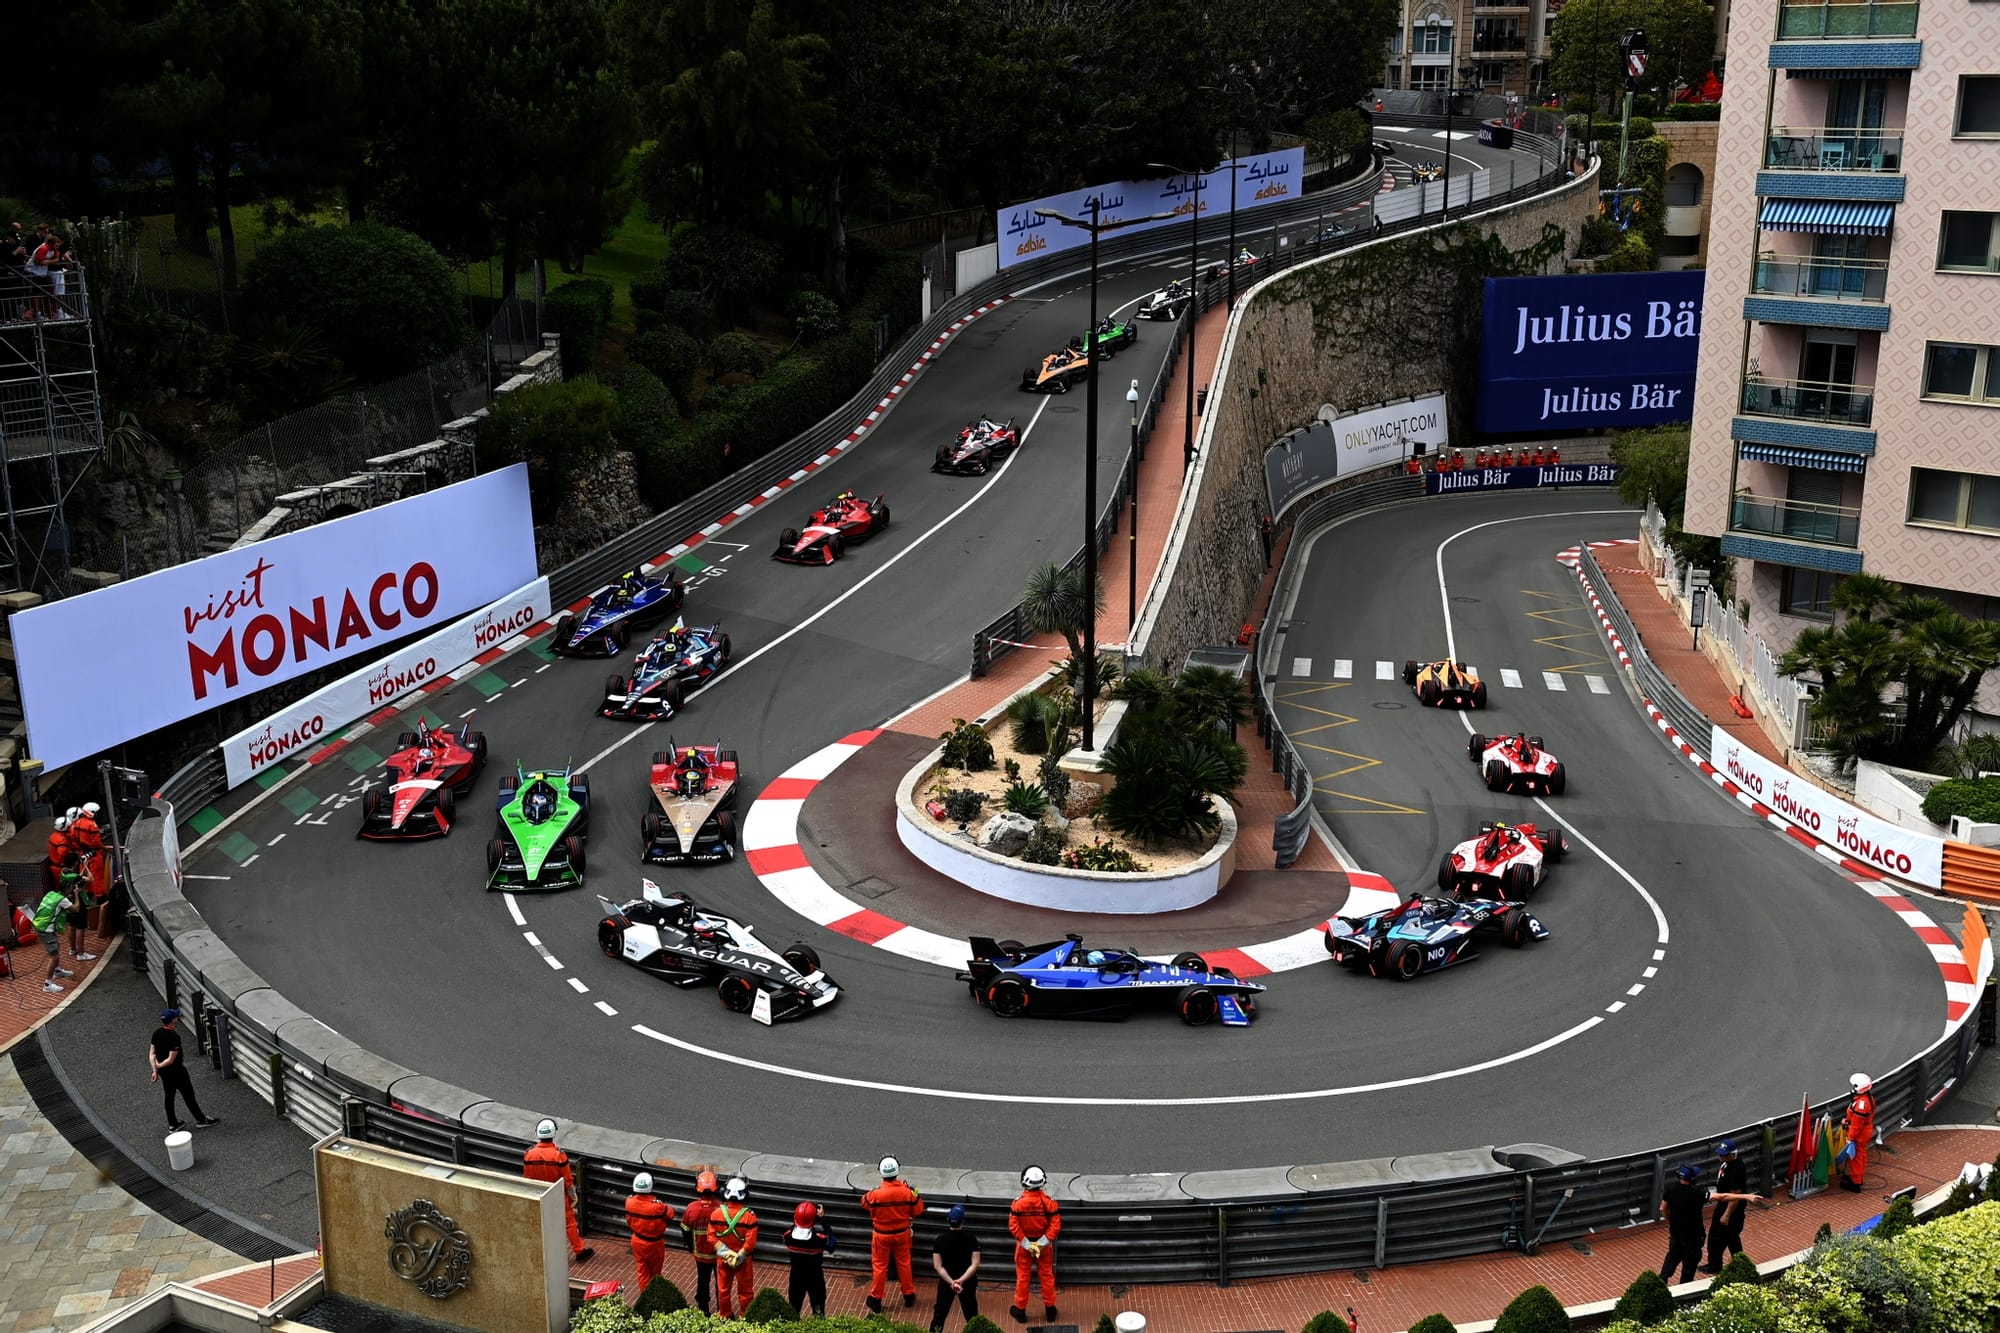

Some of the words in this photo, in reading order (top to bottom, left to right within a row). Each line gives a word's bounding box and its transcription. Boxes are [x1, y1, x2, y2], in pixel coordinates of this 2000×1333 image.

[1244, 160, 1288, 183] سابك
[1254, 181, 1288, 200] sabic
[1016, 233, 1046, 256] sabic
[1513, 305, 1632, 354] Julius
[1644, 301, 1703, 338] Bä
[1540, 387, 1621, 420] Julius
[1629, 384, 1682, 410] Bär
[1345, 413, 1437, 450] ONLYYACHT.COM
[1438, 471, 1479, 493] Julius
[1482, 469, 1511, 486] Bär
[1538, 467, 1583, 487] Julius
[1587, 465, 1617, 481] Bär
[184, 557, 274, 633] visit
[188, 562, 440, 699] MONACO
[475, 606, 534, 648] MONACO
[369, 657, 436, 705] MONACO
[250, 715, 323, 770] MONACO
[1727, 757, 1763, 795] MONACO
[1773, 789, 1821, 831] MONACO
[1837, 824, 1912, 874] MONACO
[664, 943, 773, 974] JAGUAR
[1427, 946, 1446, 962] NIO
